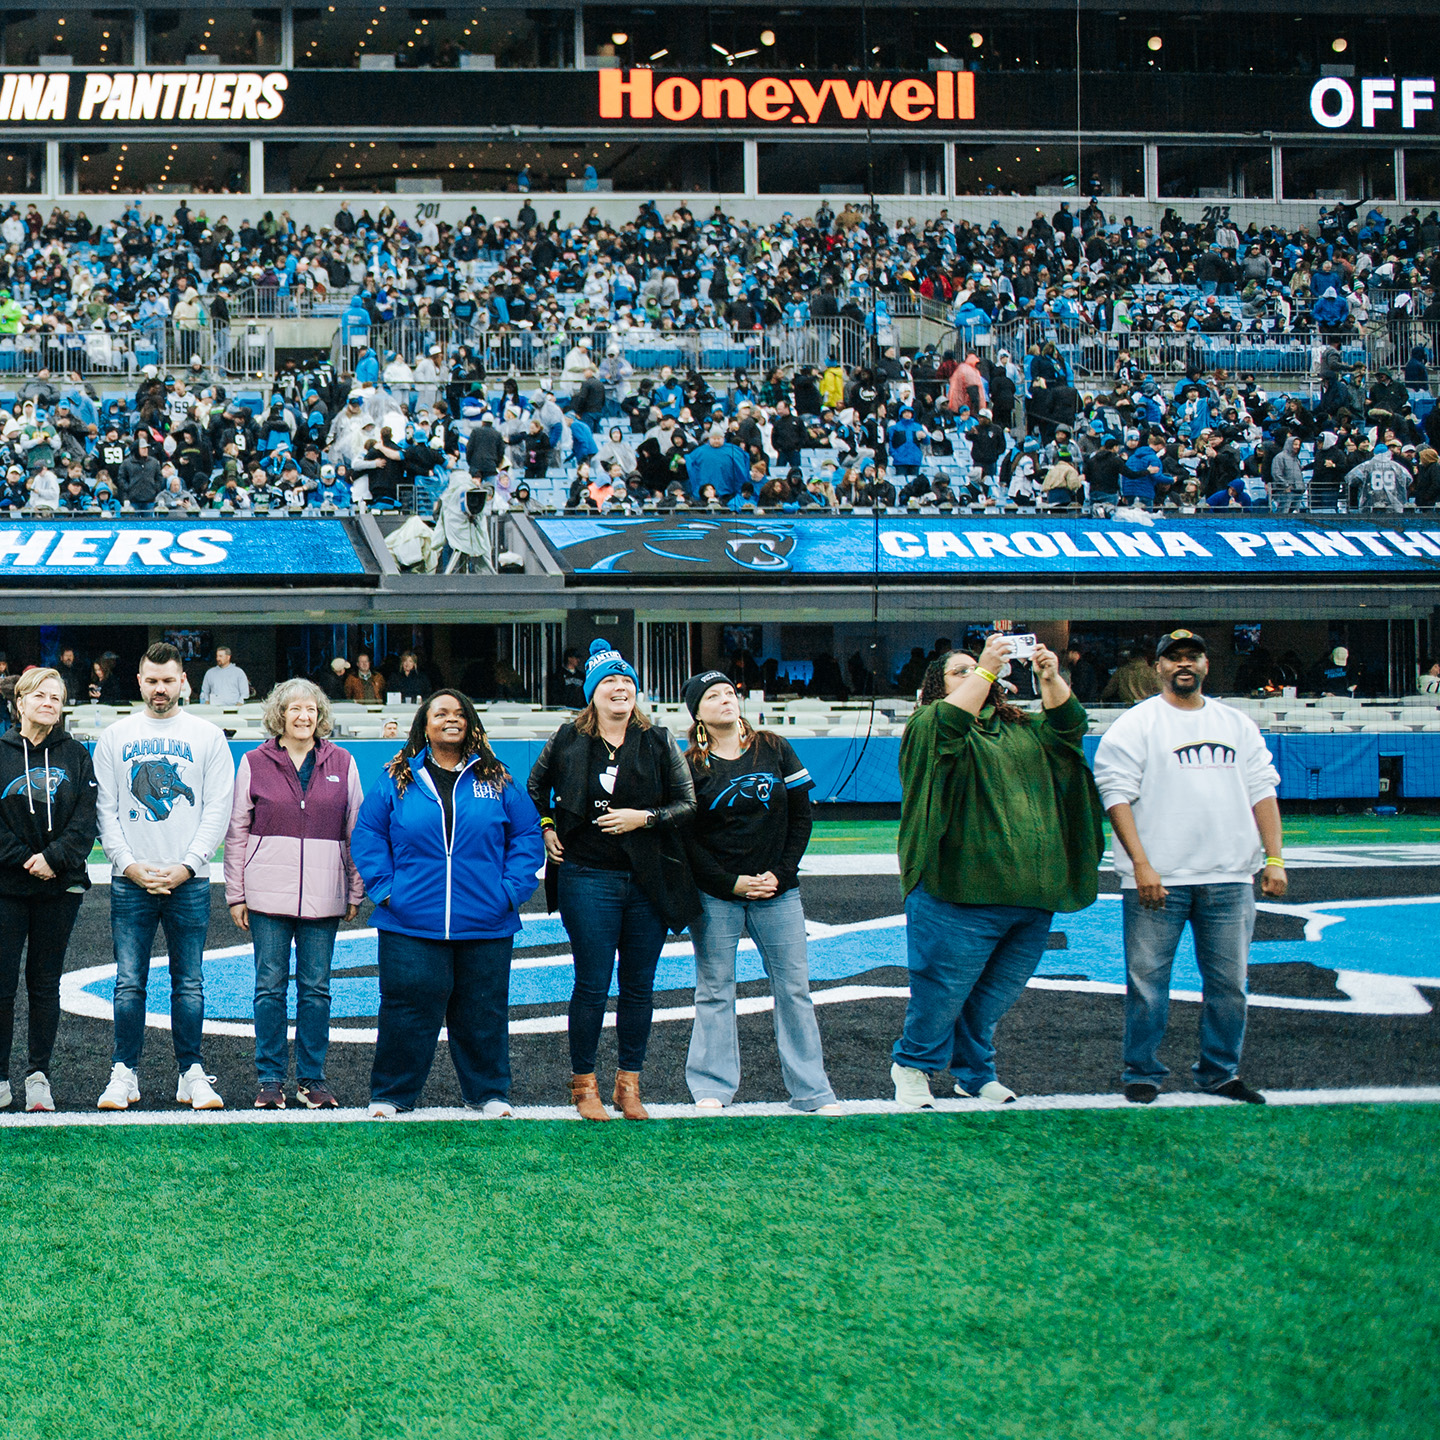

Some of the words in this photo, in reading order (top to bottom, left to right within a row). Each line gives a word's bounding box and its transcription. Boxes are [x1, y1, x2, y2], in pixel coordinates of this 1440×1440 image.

[78, 72, 289, 120] PANTHERS
[598, 67, 976, 124] Honeywell
[1310, 77, 1435, 128] OFF
[414, 202, 441, 219] 201
[1201, 205, 1232, 224] 203
[234, 434, 246, 451] 9
[103, 446, 124, 465] 59
[1370, 470, 1397, 491] 69
[877, 530, 1214, 559] CAROLINA
[122, 739, 195, 763] CAROLINA
